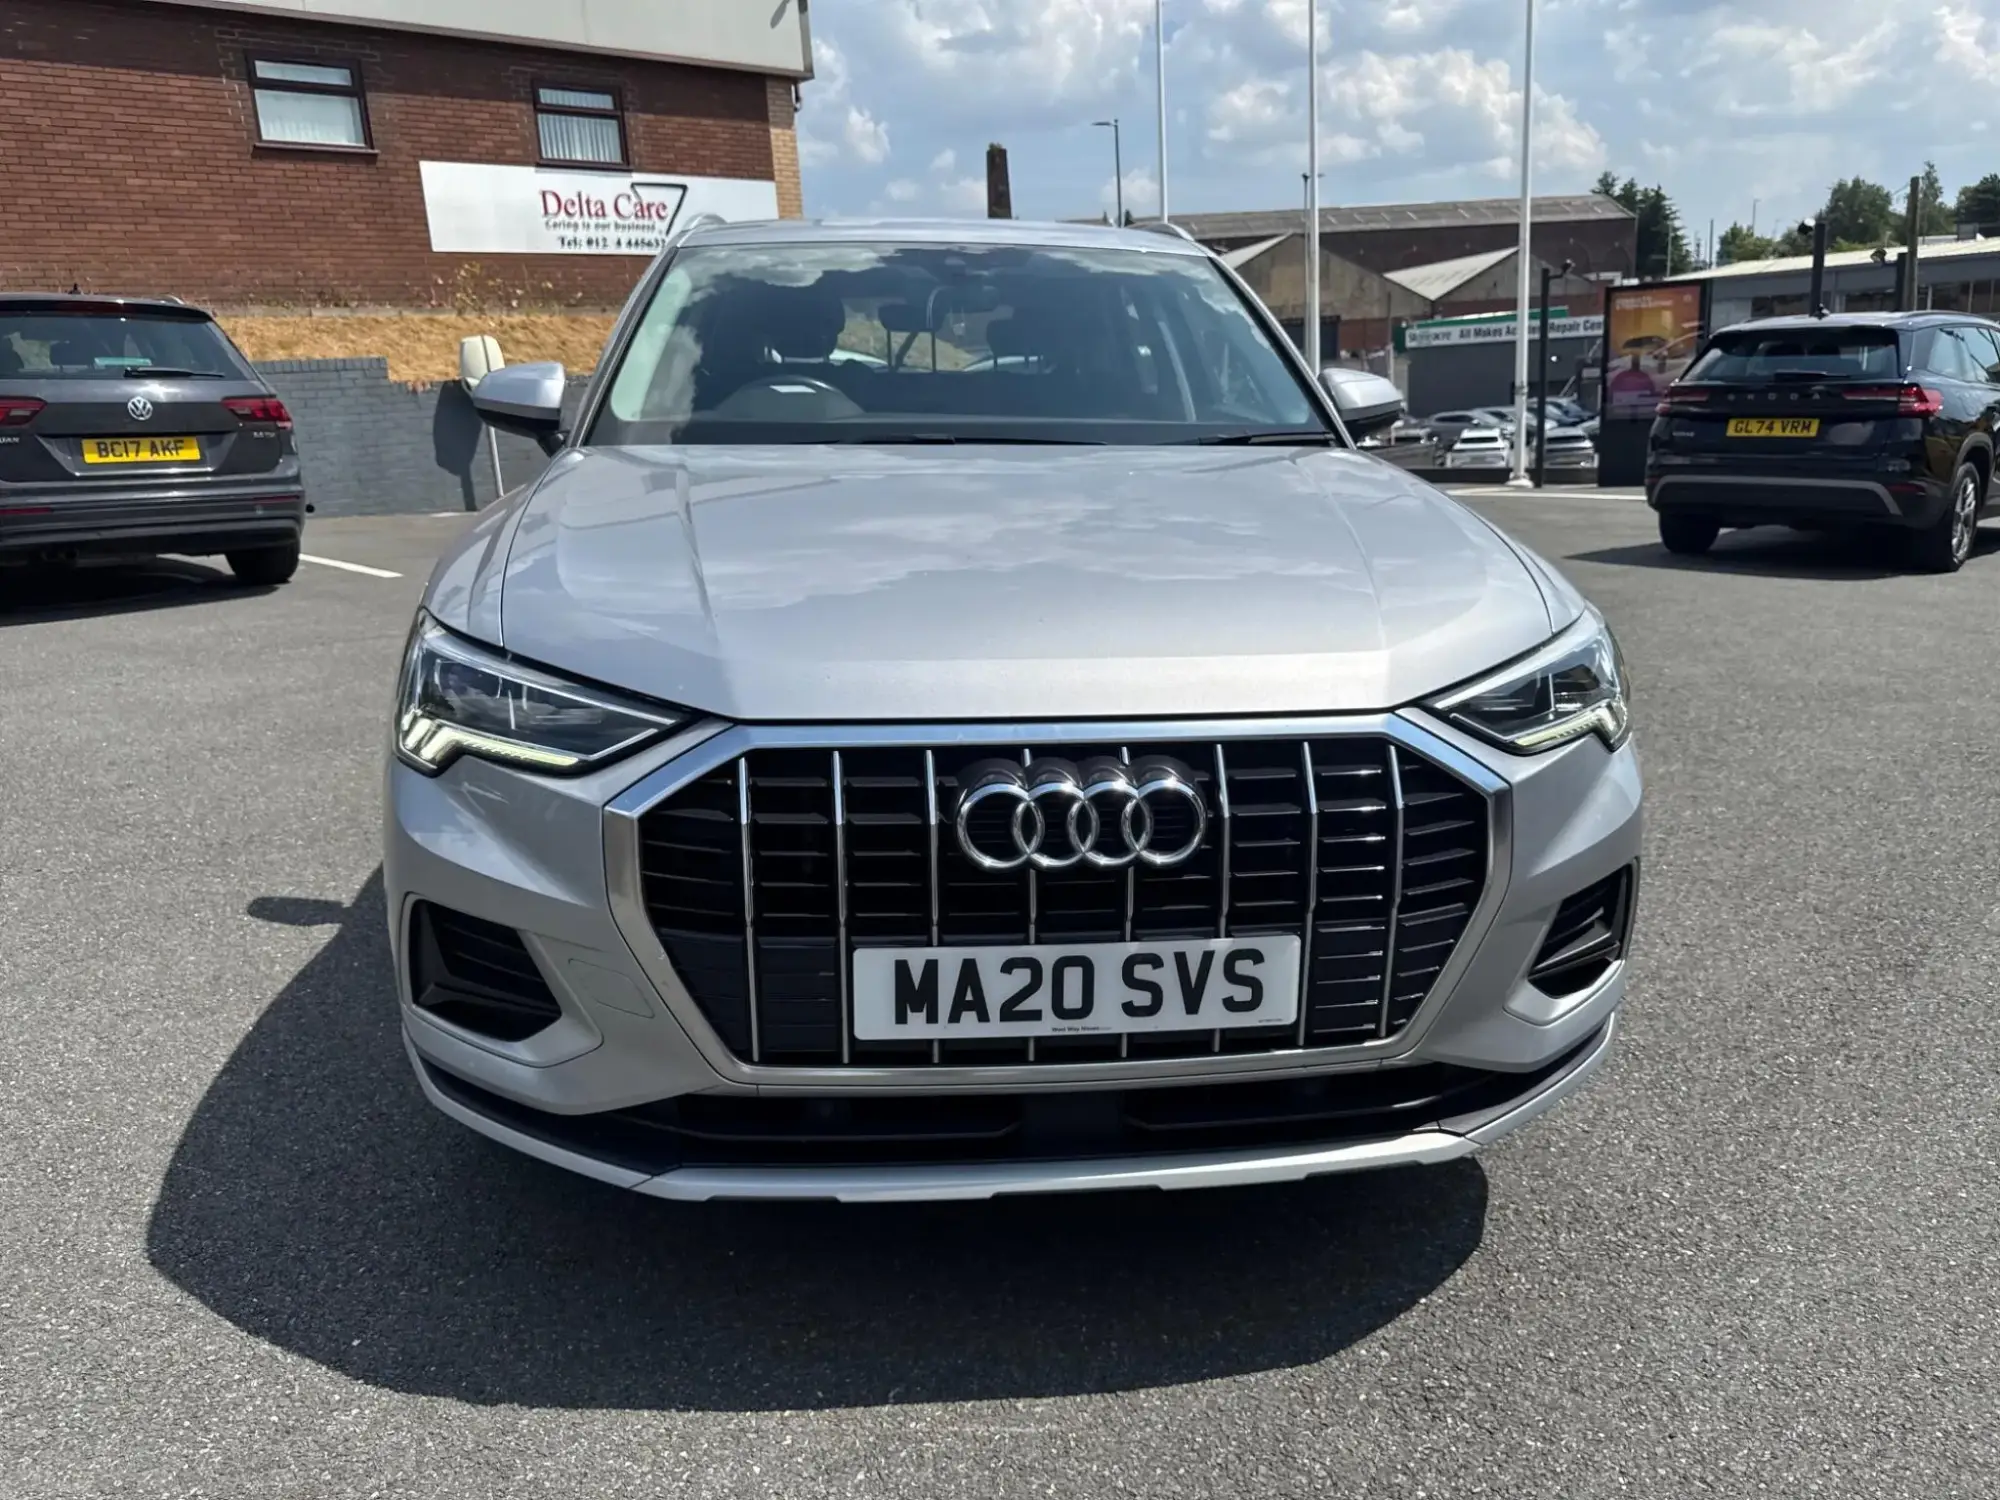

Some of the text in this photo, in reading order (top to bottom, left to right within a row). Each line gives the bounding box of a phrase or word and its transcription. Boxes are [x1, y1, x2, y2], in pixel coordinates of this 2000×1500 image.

[540, 190, 668, 220] Delta Care
[1459, 328, 1471, 339] All
[1473, 326, 1502, 338] Makes
[1549, 321, 1580, 334] Repair
[1583, 319, 1603, 331] Cen
[1734, 420, 1812, 433] GL74 VRM
[96, 440, 184, 458] BC17 AKF
[894, 948, 1265, 1024] MA20 SVS
